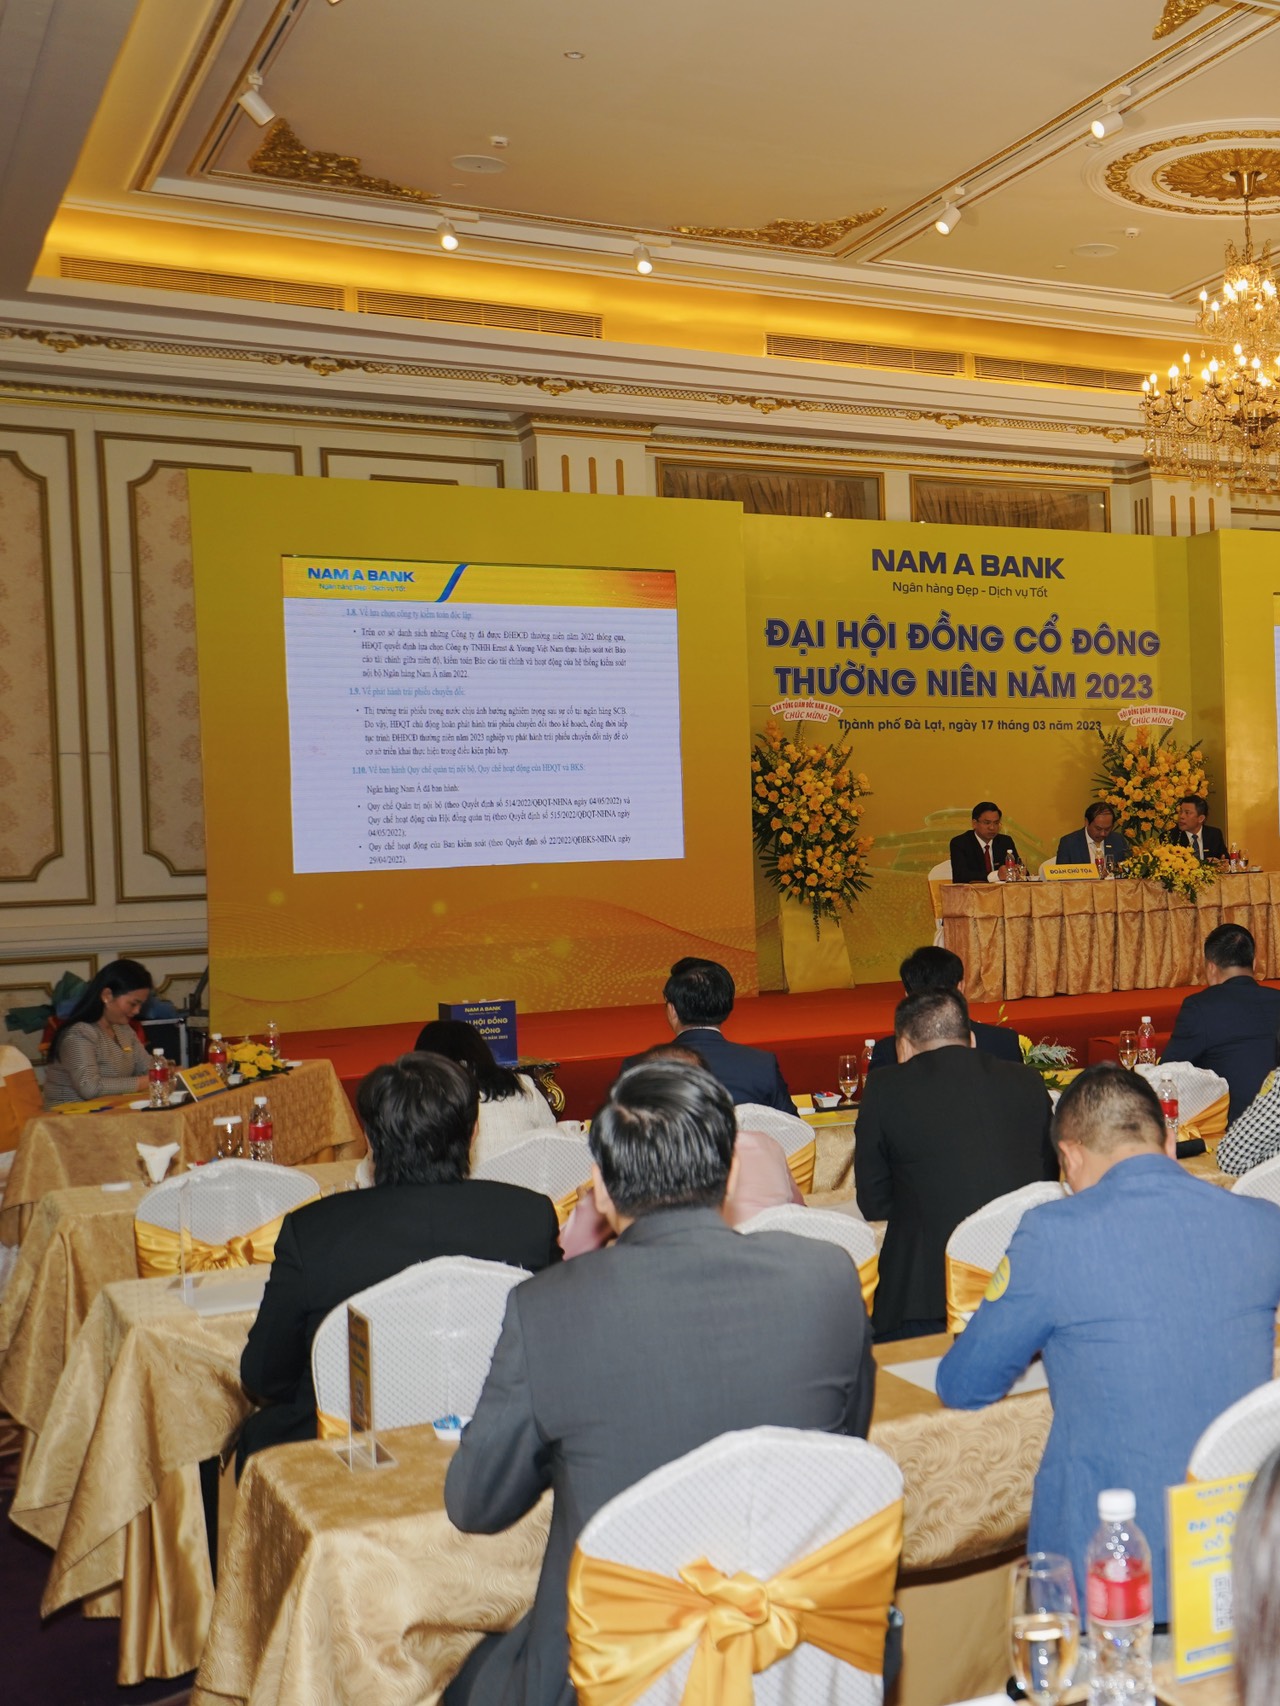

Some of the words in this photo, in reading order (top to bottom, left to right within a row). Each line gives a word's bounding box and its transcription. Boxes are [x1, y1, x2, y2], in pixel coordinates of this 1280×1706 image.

[872, 549, 946, 574] NAM
[953, 554, 974, 575] A
[981, 554, 1065, 580] BANK
[308, 568, 348, 580] NAM
[352, 570, 364, 580] A
[368, 570, 414, 582] BANK
[892, 582, 922, 594] Ngân
[926, 584, 953, 596] hàng
[956, 584, 978, 596] Đẹp
[989, 586, 1012, 598] Dịch
[1015, 588, 1028, 599] vụ
[1030, 586, 1048, 598] Tốt
[765, 618, 825, 656] ĐẠI
[836, 613, 896, 658] HỘI
[906, 609, 1004, 652] ĐỒNG
[1014, 612, 1062, 654] CỔ
[1072, 622, 1160, 656] ĐÔNG
[774, 659, 916, 696] THƯỜNG
[928, 662, 996, 698] NIÊN
[1008, 665, 1076, 698] NĂM
[1086, 672, 1153, 700] 2023
[785, 710, 804, 719] CHÚC
[806, 711, 828, 720] MỪNG
[1132, 716, 1150, 724] CHÚC
[1151, 716, 1172, 724] MỪNG
[838, 718, 874, 730] Thành
[878, 718, 902, 731] phố
[904, 718, 920, 730] Đà
[925, 720, 944, 732] Lạt,
[949, 718, 977, 732] ngày
[982, 720, 994, 730] 17
[998, 720, 1029, 732] tháng
[1032, 720, 1046, 730] 03
[1050, 720, 1073, 730] năm
[1076, 720, 1101, 730] 2023
